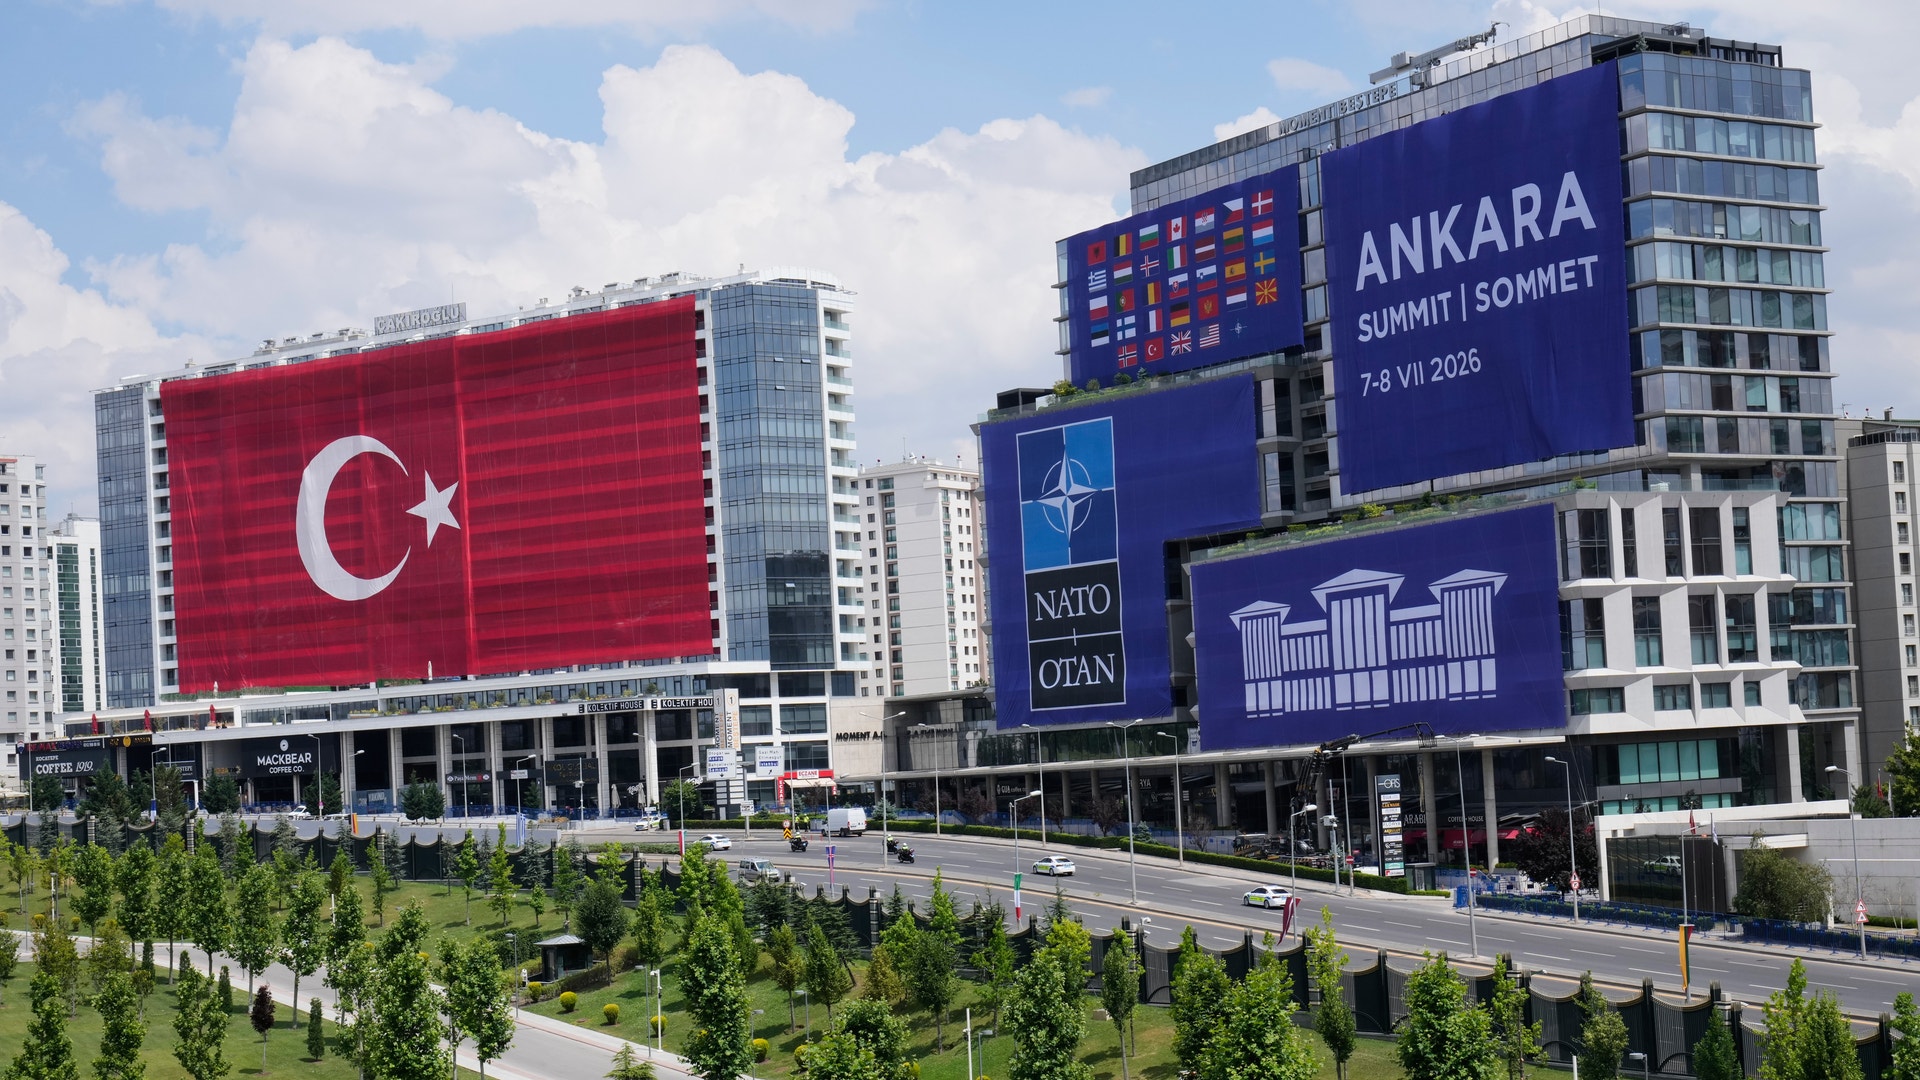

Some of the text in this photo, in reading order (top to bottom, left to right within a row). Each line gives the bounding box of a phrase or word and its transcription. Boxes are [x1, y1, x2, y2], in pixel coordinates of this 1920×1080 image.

[1279, 104, 1336, 135] MOMENT
[1356, 171, 1597, 292] ANKARA
[1357, 291, 1452, 343] SUMMIT
[1475, 255, 1599, 313] SOMMET
[1360, 348, 1482, 397] 7-8 VII 2026
[1034, 583, 1111, 621] NATO
[1039, 653, 1115, 689] OTAN
[620, 700, 643, 710] HOUSE
[698, 698, 713, 707] HOU
[836, 731, 871, 741] MOMENT
[36, 763, 73, 774] COFFEE
[257, 752, 312, 766] MACKBEAR
[269, 765, 304, 774] COFFEE CO.
